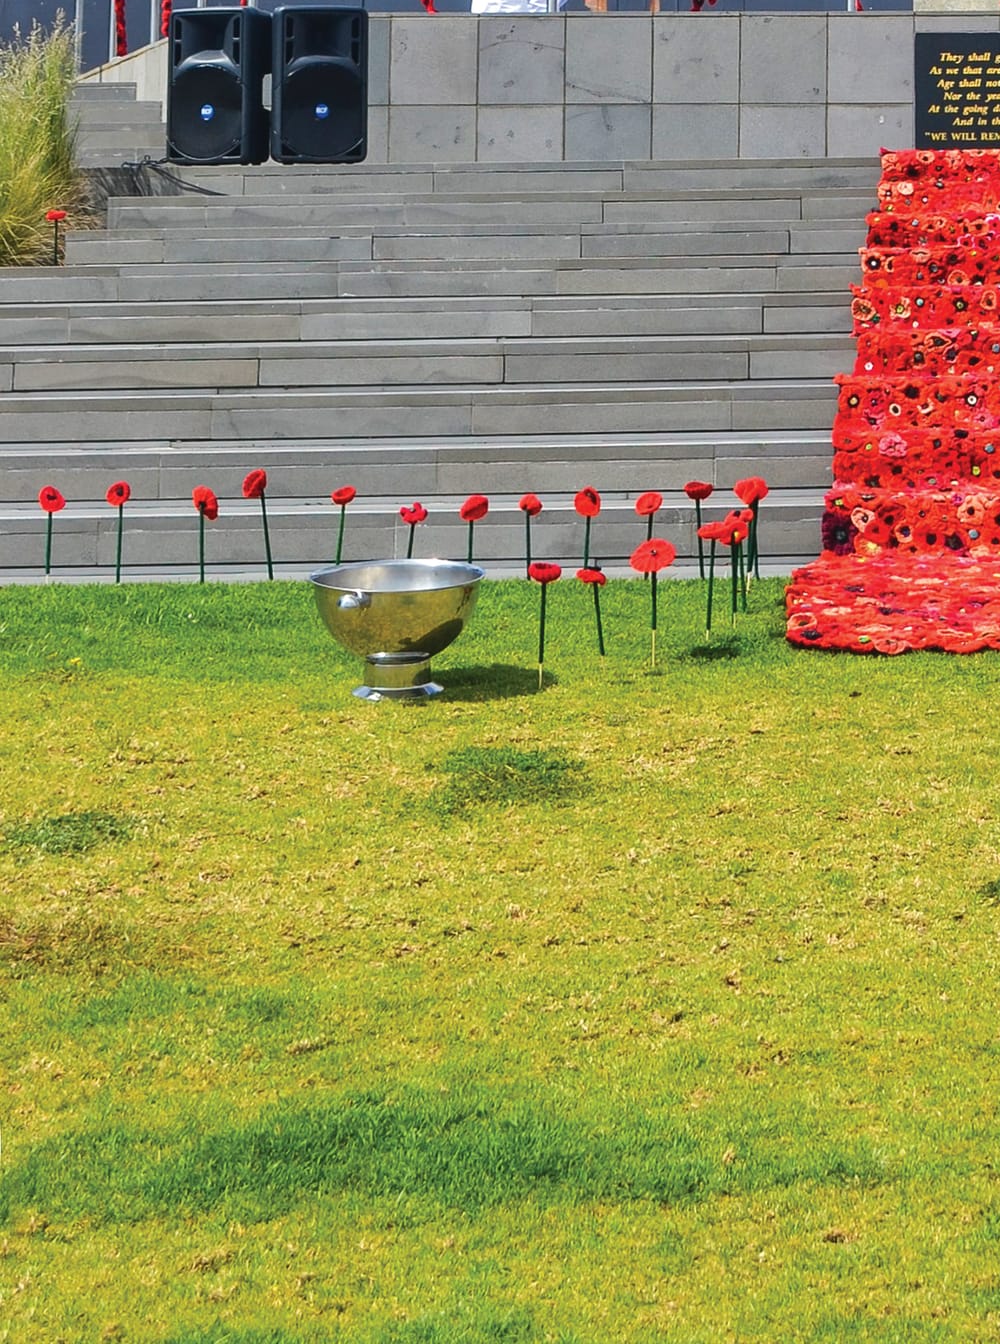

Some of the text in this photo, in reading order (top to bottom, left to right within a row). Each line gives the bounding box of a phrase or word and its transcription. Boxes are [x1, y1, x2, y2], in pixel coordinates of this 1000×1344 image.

[940, 52, 964, 64] They
[968, 52, 991, 62] shall
[929, 66, 942, 75] As
[963, 66, 983, 75] that
[937, 79, 955, 91] Age
[959, 78, 982, 88] shall
[943, 92, 962, 101] Nor
[966, 92, 981, 101] the
[928, 105, 940, 114] At
[944, 104, 959, 113] the
[963, 104, 988, 115] going
[952, 117, 974, 126] And
[977, 117, 987, 126] in
[951, 132, 977, 141] WILL
